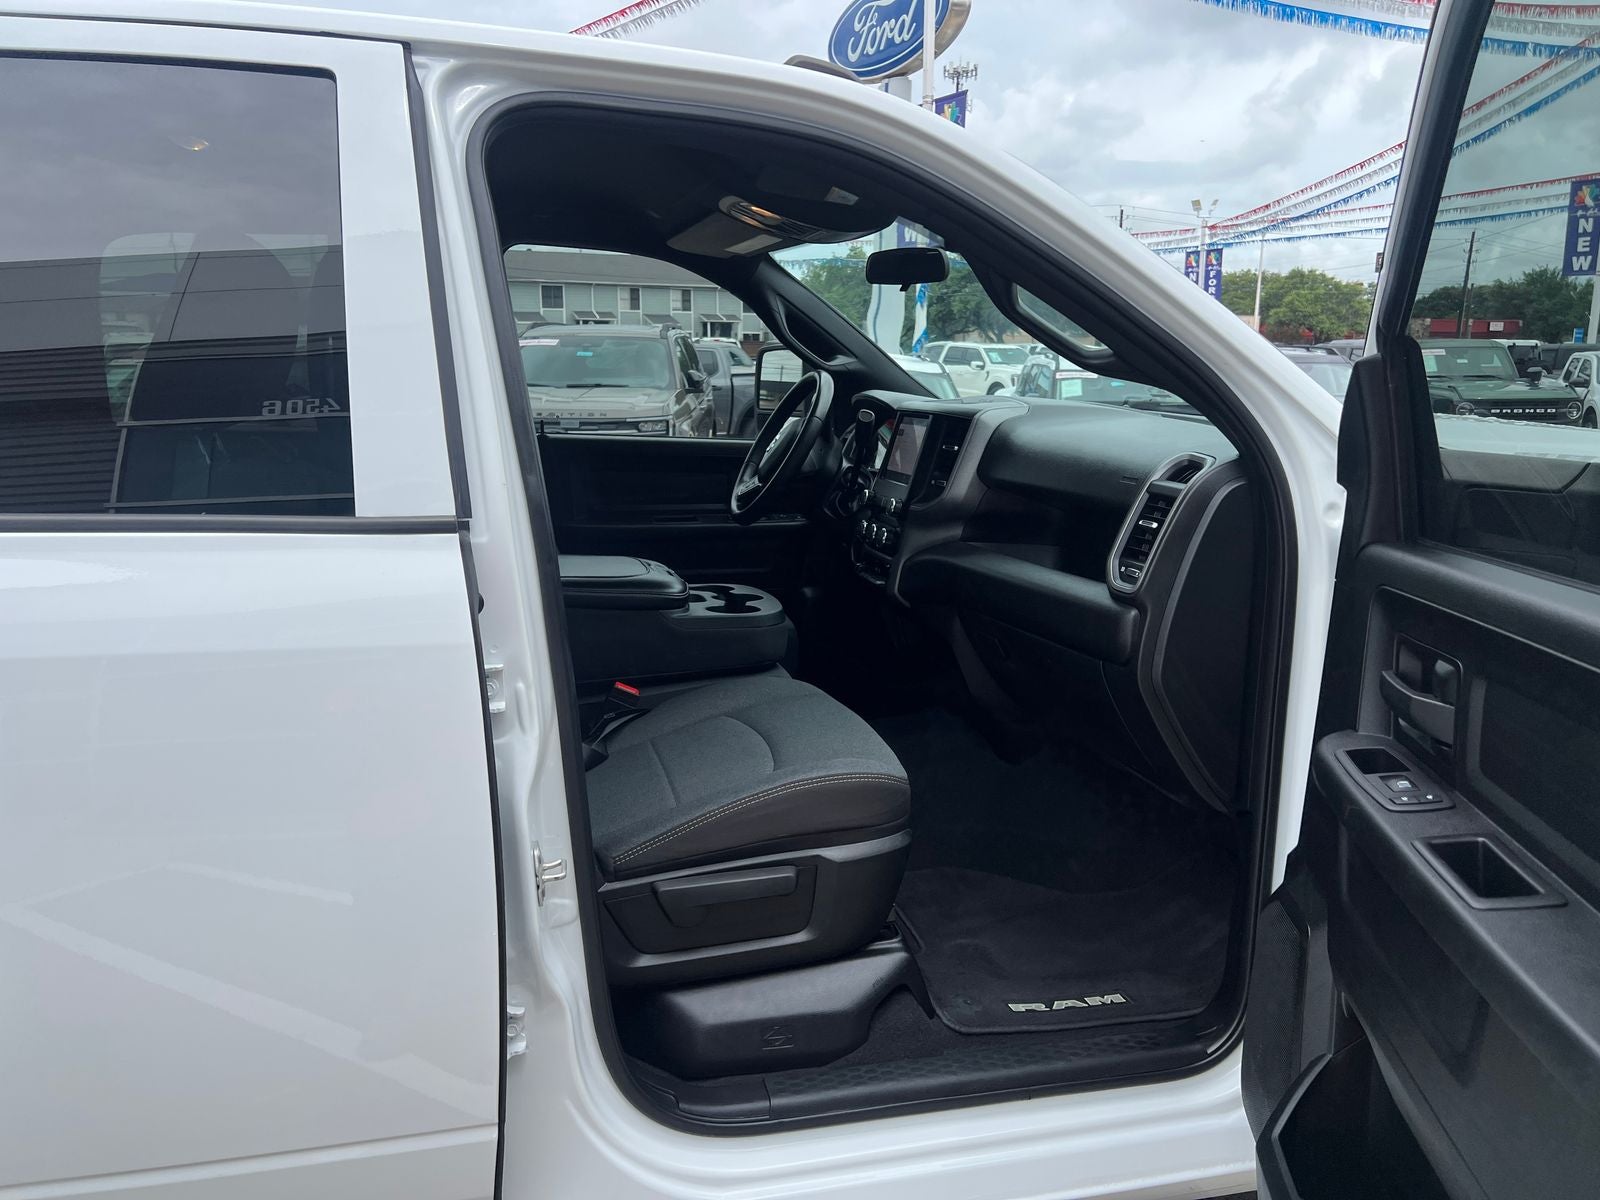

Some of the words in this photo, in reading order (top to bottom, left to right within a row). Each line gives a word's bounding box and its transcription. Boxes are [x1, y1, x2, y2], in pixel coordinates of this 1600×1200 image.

[847, 0, 917, 62] Ford
[1571, 217, 1594, 272] NEW
[1208, 271, 1217, 299] FOR
[1007, 993, 1127, 1013] RAM
